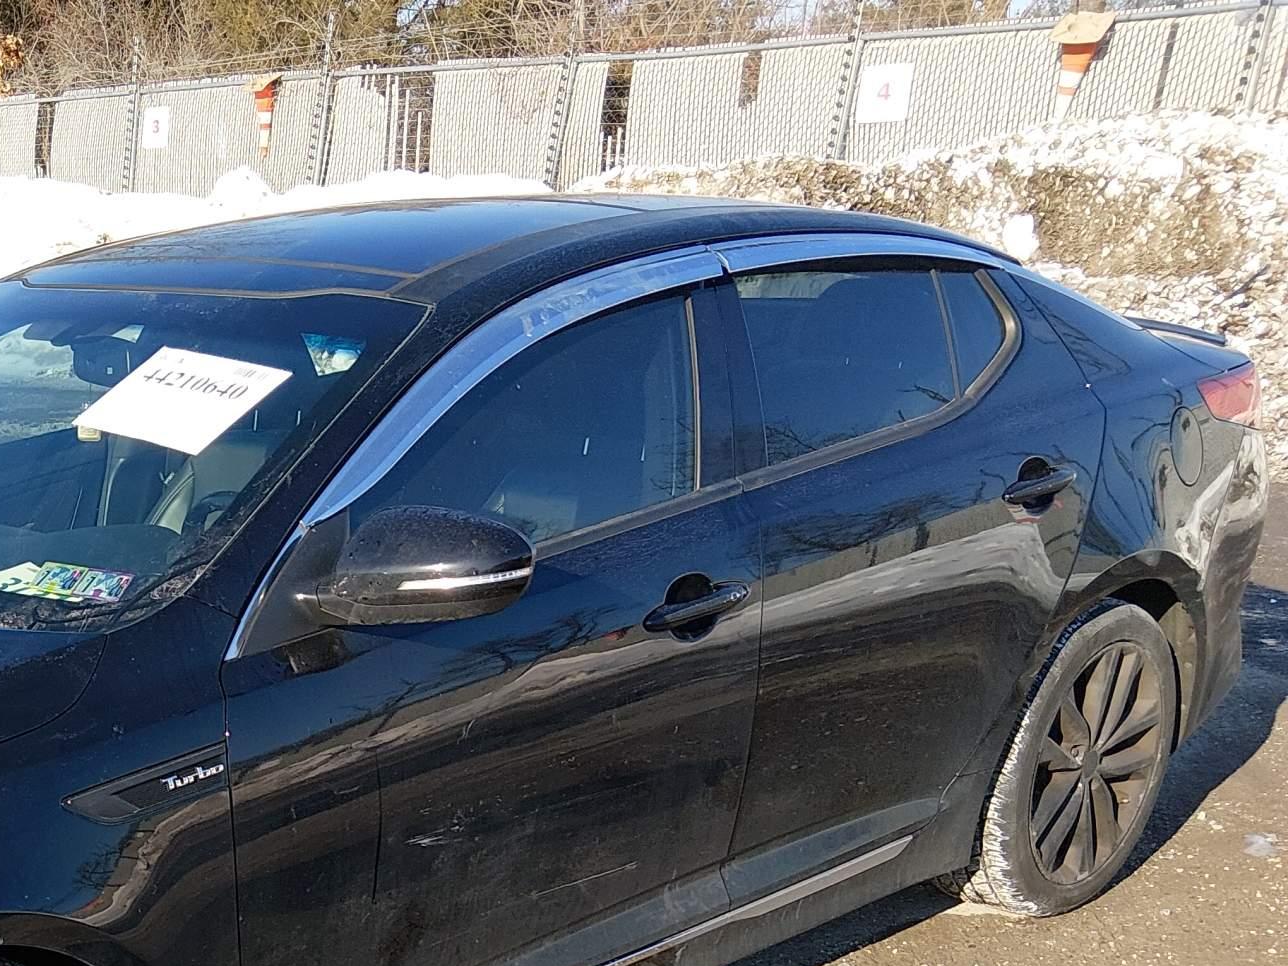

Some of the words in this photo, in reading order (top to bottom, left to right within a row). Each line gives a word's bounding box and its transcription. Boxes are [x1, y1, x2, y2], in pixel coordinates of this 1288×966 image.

[877, 82, 891, 101] 4
[152, 119, 160, 134] 3
[143, 368, 249, 400] 44210640
[161, 763, 224, 790] Turbo
